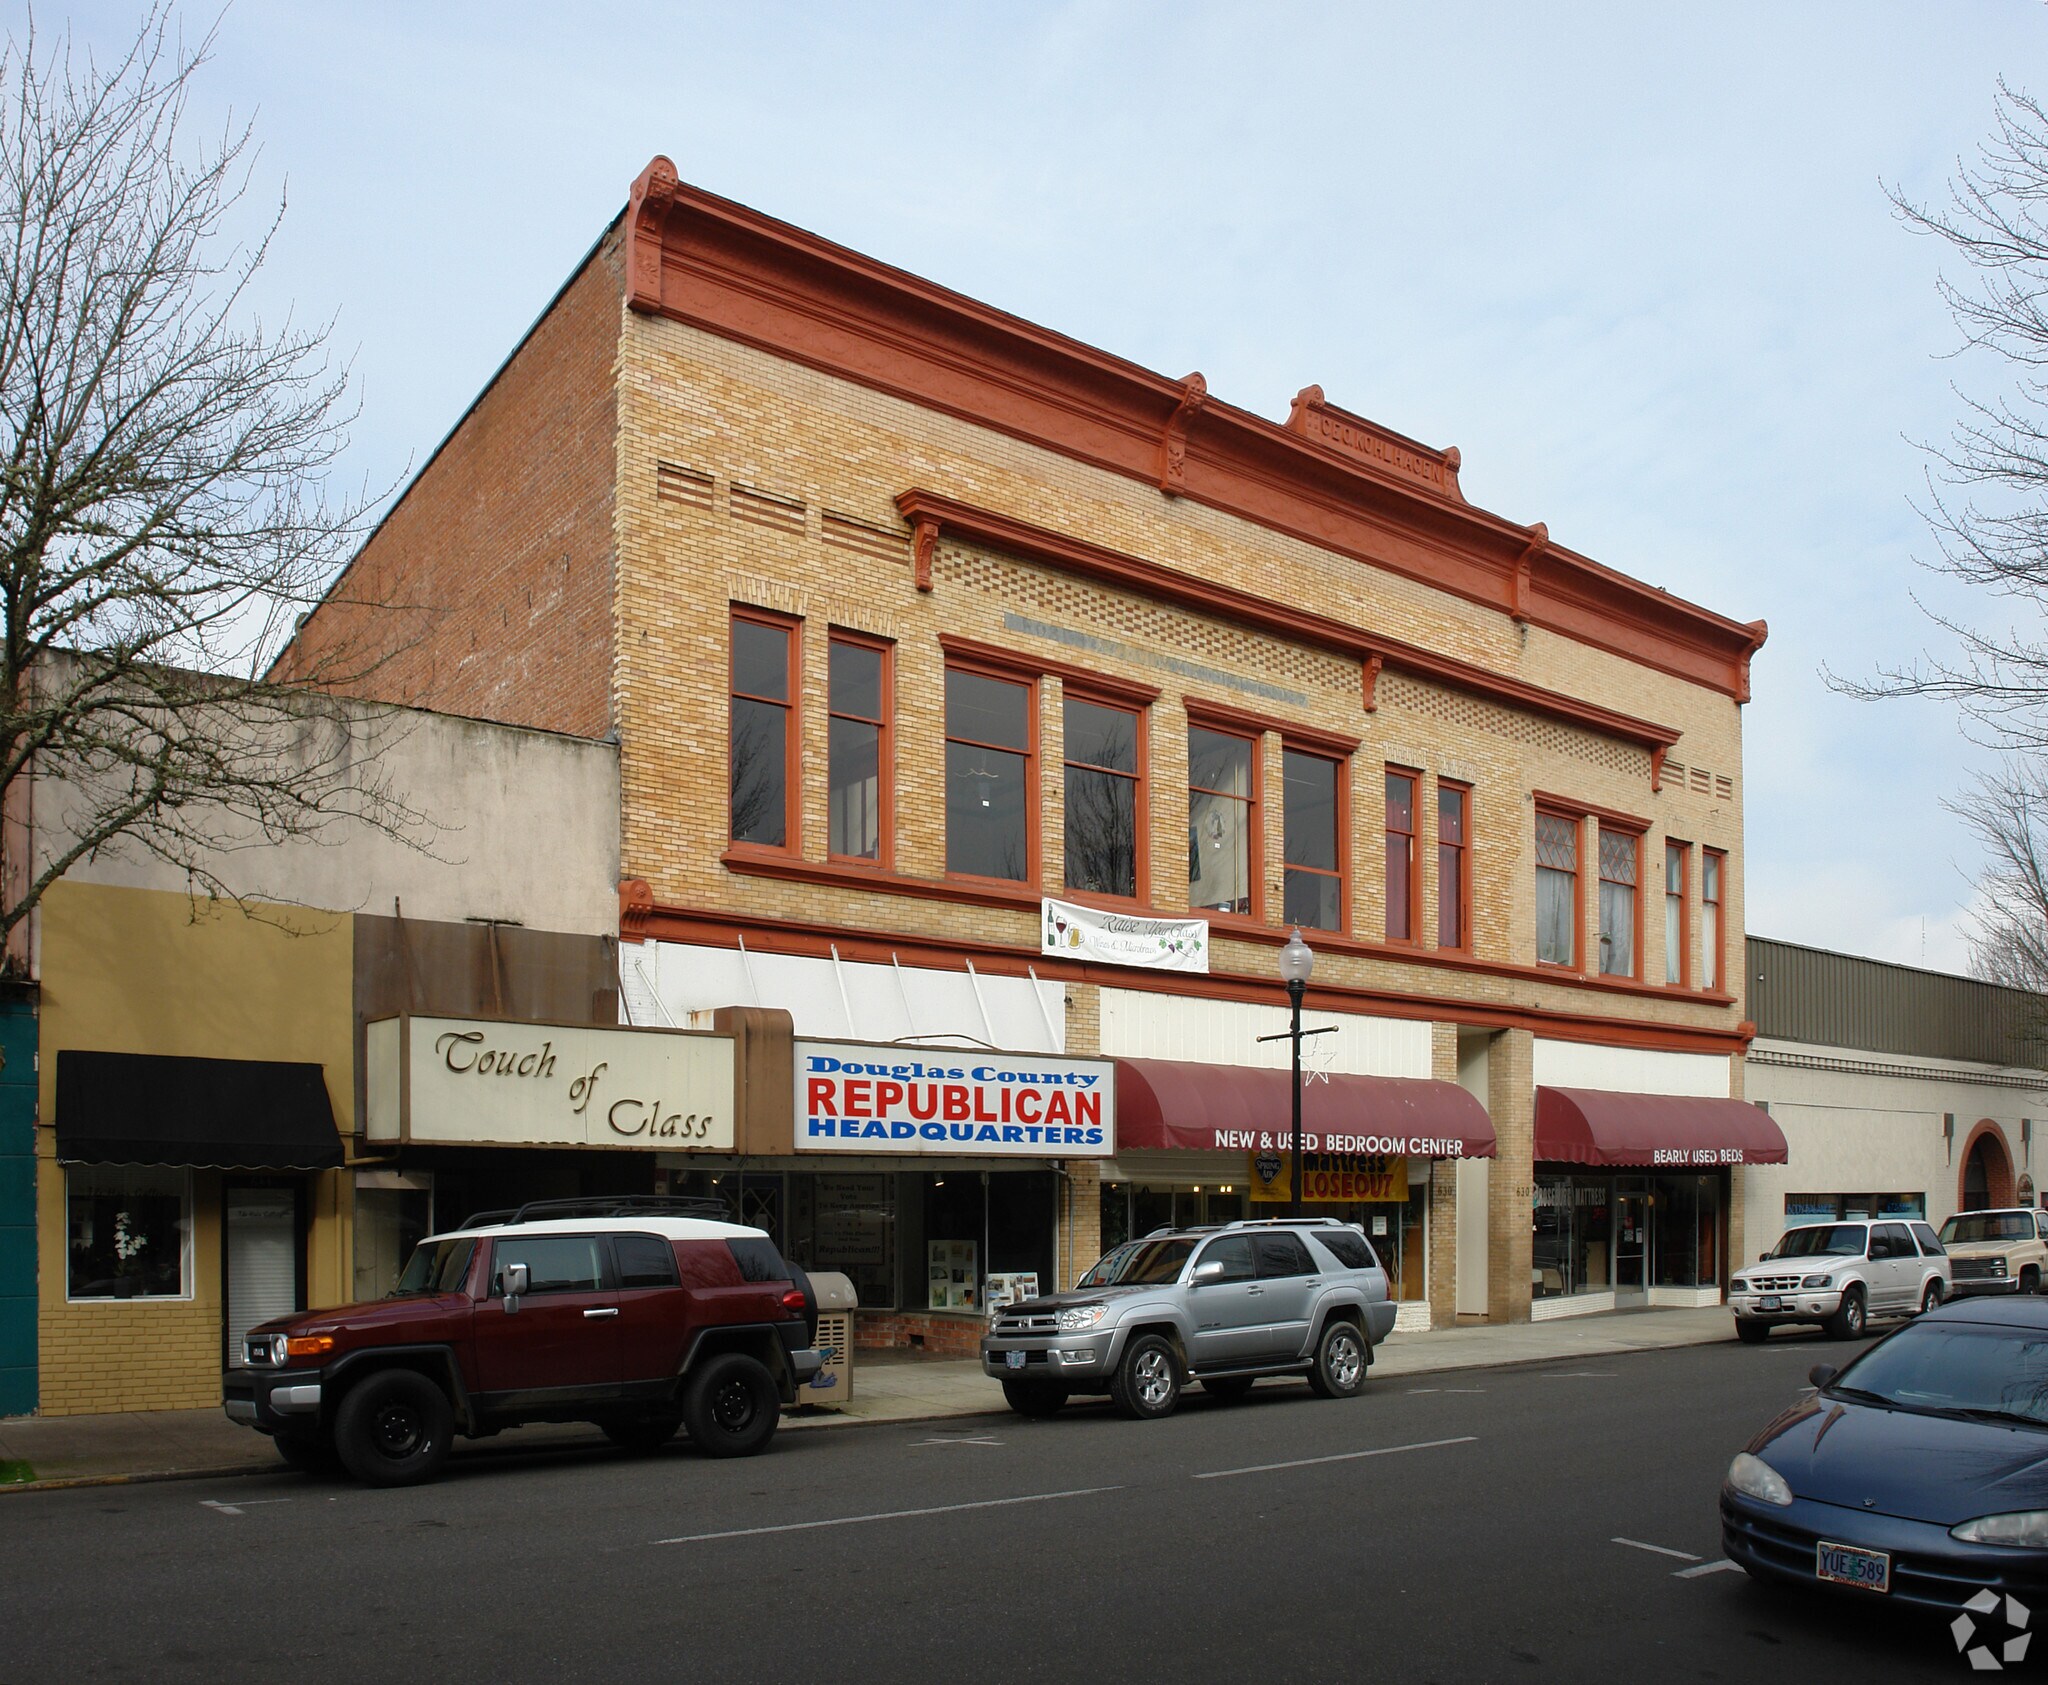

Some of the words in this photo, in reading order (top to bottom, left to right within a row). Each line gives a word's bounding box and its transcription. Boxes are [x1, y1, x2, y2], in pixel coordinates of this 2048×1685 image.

[1099, 915, 1140, 934] Raise
[435, 1031, 557, 1078] Touch
[806, 1056, 965, 1083] Douglas
[971, 1066, 1100, 1088] County
[569, 1062, 608, 1114] of
[807, 1077, 1101, 1126] REPUBLICAN
[608, 1099, 713, 1138] Class
[807, 1118, 1104, 1145] HEADQUARTERS
[1215, 1129, 1255, 1149] NEW
[1260, 1131, 1273, 1149] &
[1326, 1134, 1406, 1154] BEDROOM
[1409, 1137, 1463, 1156] CENTER
[1653, 1149, 1690, 1164] BEARLY
[1692, 1150, 1717, 1163] USED
[1720, 1149, 1744, 1163] BEDS
[1291, 1173, 1394, 1199] LOSEOUT
[1516, 1186, 1530, 1197] 630
[1821, 1551, 1848, 1574] YUE
[1857, 1558, 1885, 1582] 589
